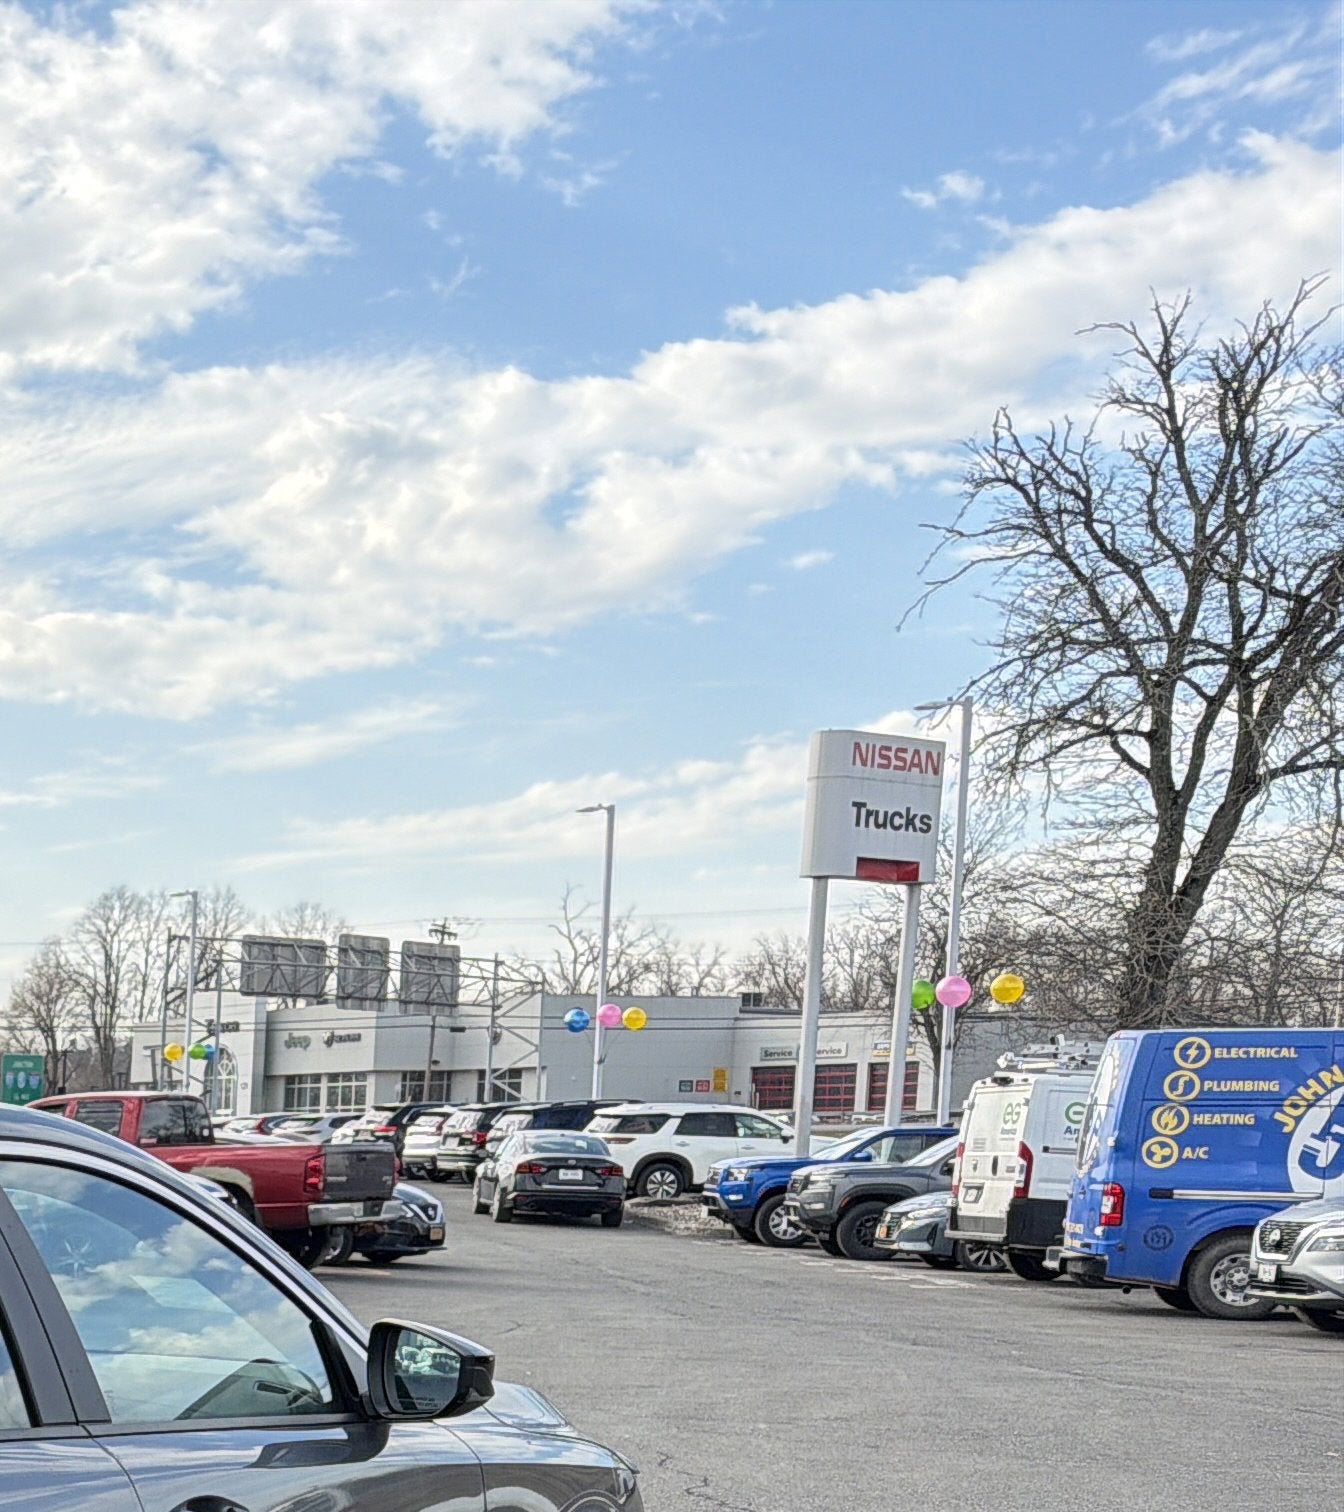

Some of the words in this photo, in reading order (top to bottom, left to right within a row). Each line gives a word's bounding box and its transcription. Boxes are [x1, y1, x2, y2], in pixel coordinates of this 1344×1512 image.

[852, 742, 942, 776] NISSAN
[852, 801, 933, 834] Trucks
[764, 1049, 793, 1058] Service
[817, 1046, 843, 1056] ervice
[1214, 1047, 1298, 1059] ELECTRICAL
[1203, 1080, 1280, 1092] PLUMBING
[1273, 1064, 1344, 1133] JOHN
[1193, 1113, 1255, 1126] HEATING
[1181, 1147, 1210, 1160] A/C
